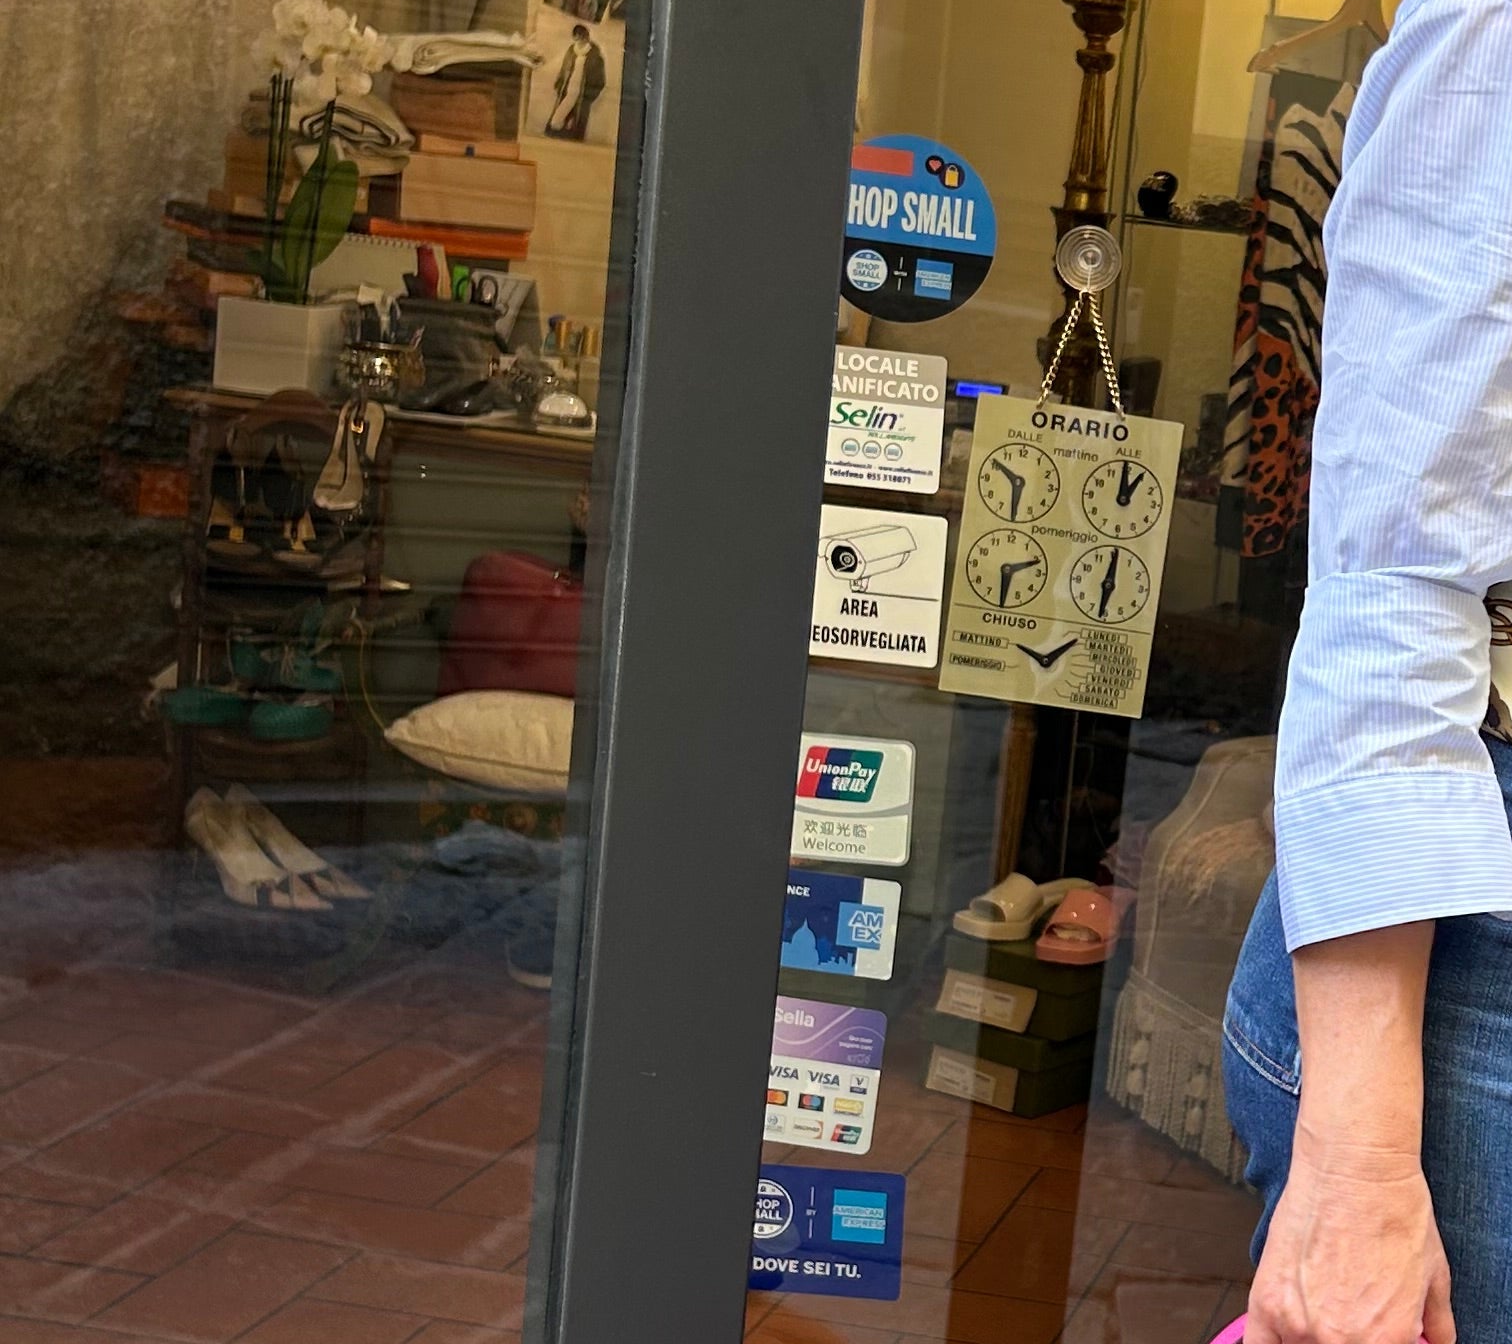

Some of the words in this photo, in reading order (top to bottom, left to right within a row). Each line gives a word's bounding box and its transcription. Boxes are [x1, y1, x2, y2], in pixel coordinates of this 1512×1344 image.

[901, 191, 976, 241] SMALL
[837, 352, 919, 377] LOCALE
[832, 374, 939, 402] ANIFICATO
[831, 402, 898, 431] Selin
[1032, 411, 1129, 441] ORARIO
[1007, 428, 1043, 443] DALLE
[1053, 447, 1099, 462] mattino
[1115, 447, 1142, 459] ALLE
[1031, 524, 1099, 544] pomeriggio
[840, 598, 879, 618] AREA
[982, 612, 1037, 630] CHIUSO
[812, 625, 927, 653] EOSORVEGLIATA
[960, 632, 1002, 646] MATTINO
[806, 758, 876, 784] UnionPay
[803, 820, 867, 838] 欢迎光临
[803, 837, 866, 854] Welcome
[849, 910, 884, 928] AM
[852, 927, 882, 944] EX
[769, 1065, 799, 1080] VISA
[808, 1070, 840, 1086] VISA
[833, 1206, 884, 1218] AMERICAN
[753, 1257, 799, 1273] DOVE
[803, 1260, 830, 1276] SEI
[834, 1263, 862, 1278] TU.
